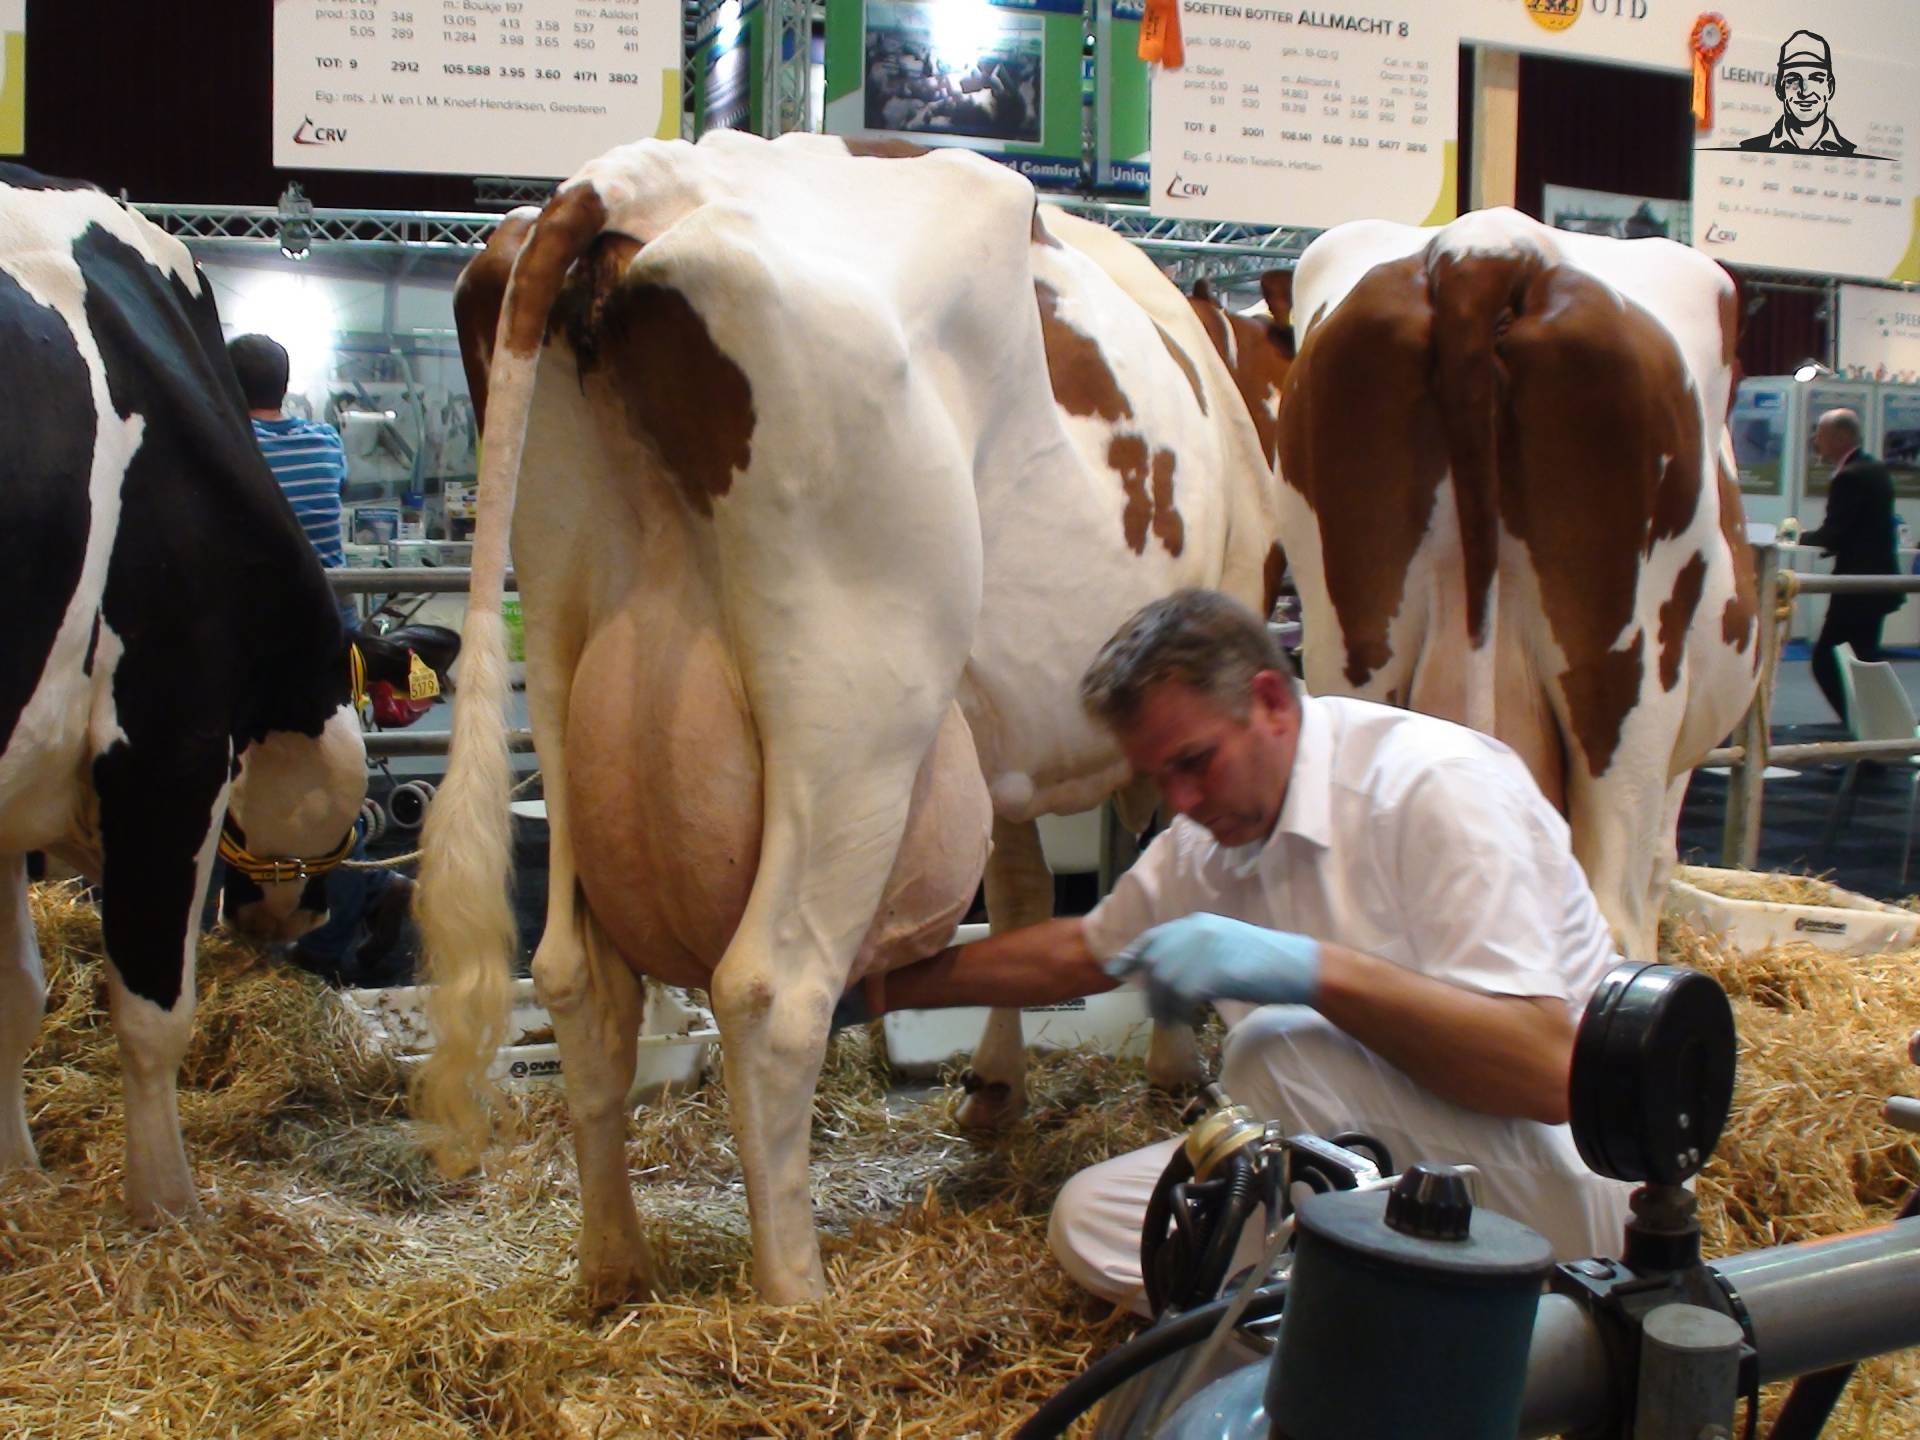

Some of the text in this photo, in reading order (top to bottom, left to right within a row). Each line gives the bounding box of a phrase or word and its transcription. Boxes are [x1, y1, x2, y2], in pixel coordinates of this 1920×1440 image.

[505, 3, 523, 13] 197
[350, 9, 375, 20] 3.03
[391, 11, 413, 22] 348
[443, 15, 477, 26] 13.015
[499, 18, 520, 29] 4.13
[535, 19, 560, 31] 3.58
[573, 22, 594, 33] 537
[617, 25, 639, 36] 466
[1184, 1, 1409, 37] SOETTEN BOTTER ALLMACHT 8
[350, 26, 375, 37] 5.05
[443, 31, 476, 42] 11.284
[500, 34, 524, 45] 3.98
[535, 35, 560, 47] 3.65
[573, 38, 595, 49] 450
[623, 42, 639, 52] 411
[349, 59, 358, 69] 9
[391, 61, 419, 72] 2912
[443, 64, 490, 76] 105.588
[499, 67, 525, 78] 3.95
[535, 69, 561, 80] 3.60
[573, 72, 598, 82] 4171
[608, 73, 638, 84] 3802
[400, 97, 414, 105] en
[315, 128, 347, 142] CRV
[1022, 161, 1081, 178] Comfort
[1184, 183, 1208, 196] CRV
